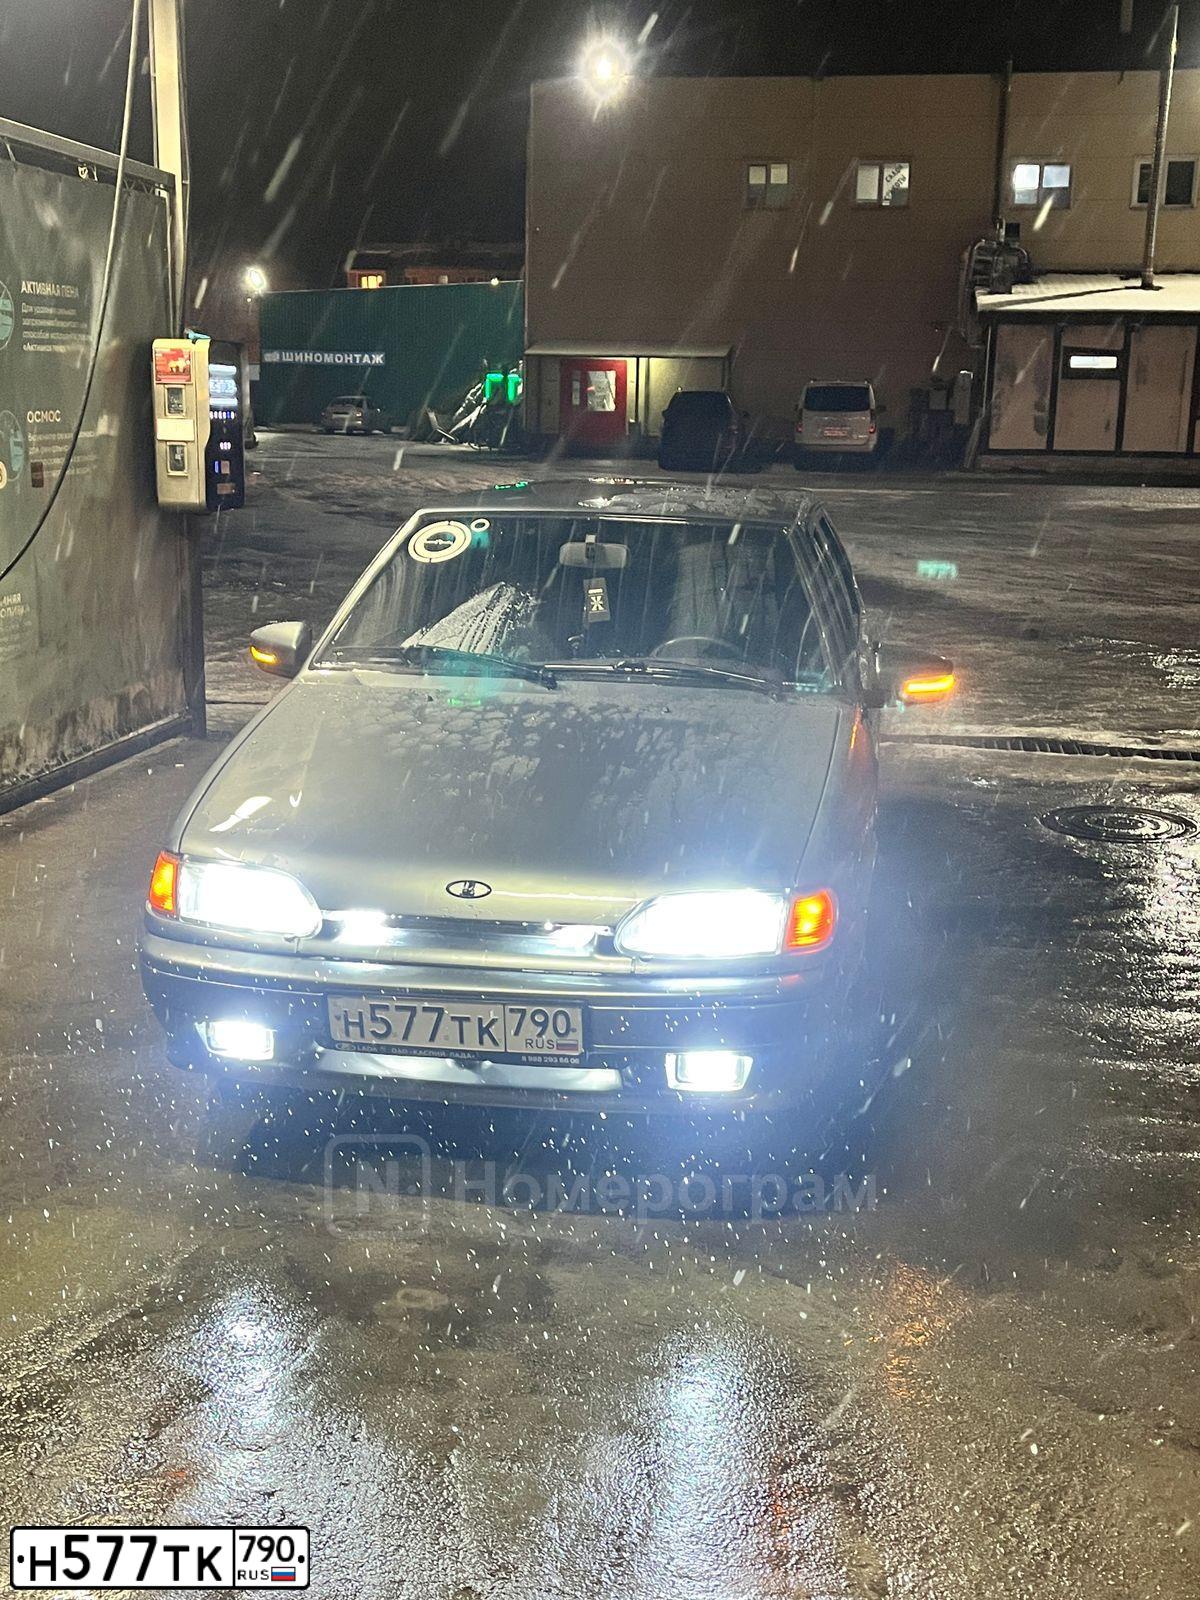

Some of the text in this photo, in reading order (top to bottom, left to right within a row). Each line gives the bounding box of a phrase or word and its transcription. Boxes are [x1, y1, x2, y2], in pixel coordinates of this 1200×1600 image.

[282, 351, 385, 364] ШИНОМОНТАЖ
[27, 410, 61, 423] ОСМОС
[343, 1003, 572, 1048] Н577ТК 790
[525, 1038, 555, 1049] RUS
